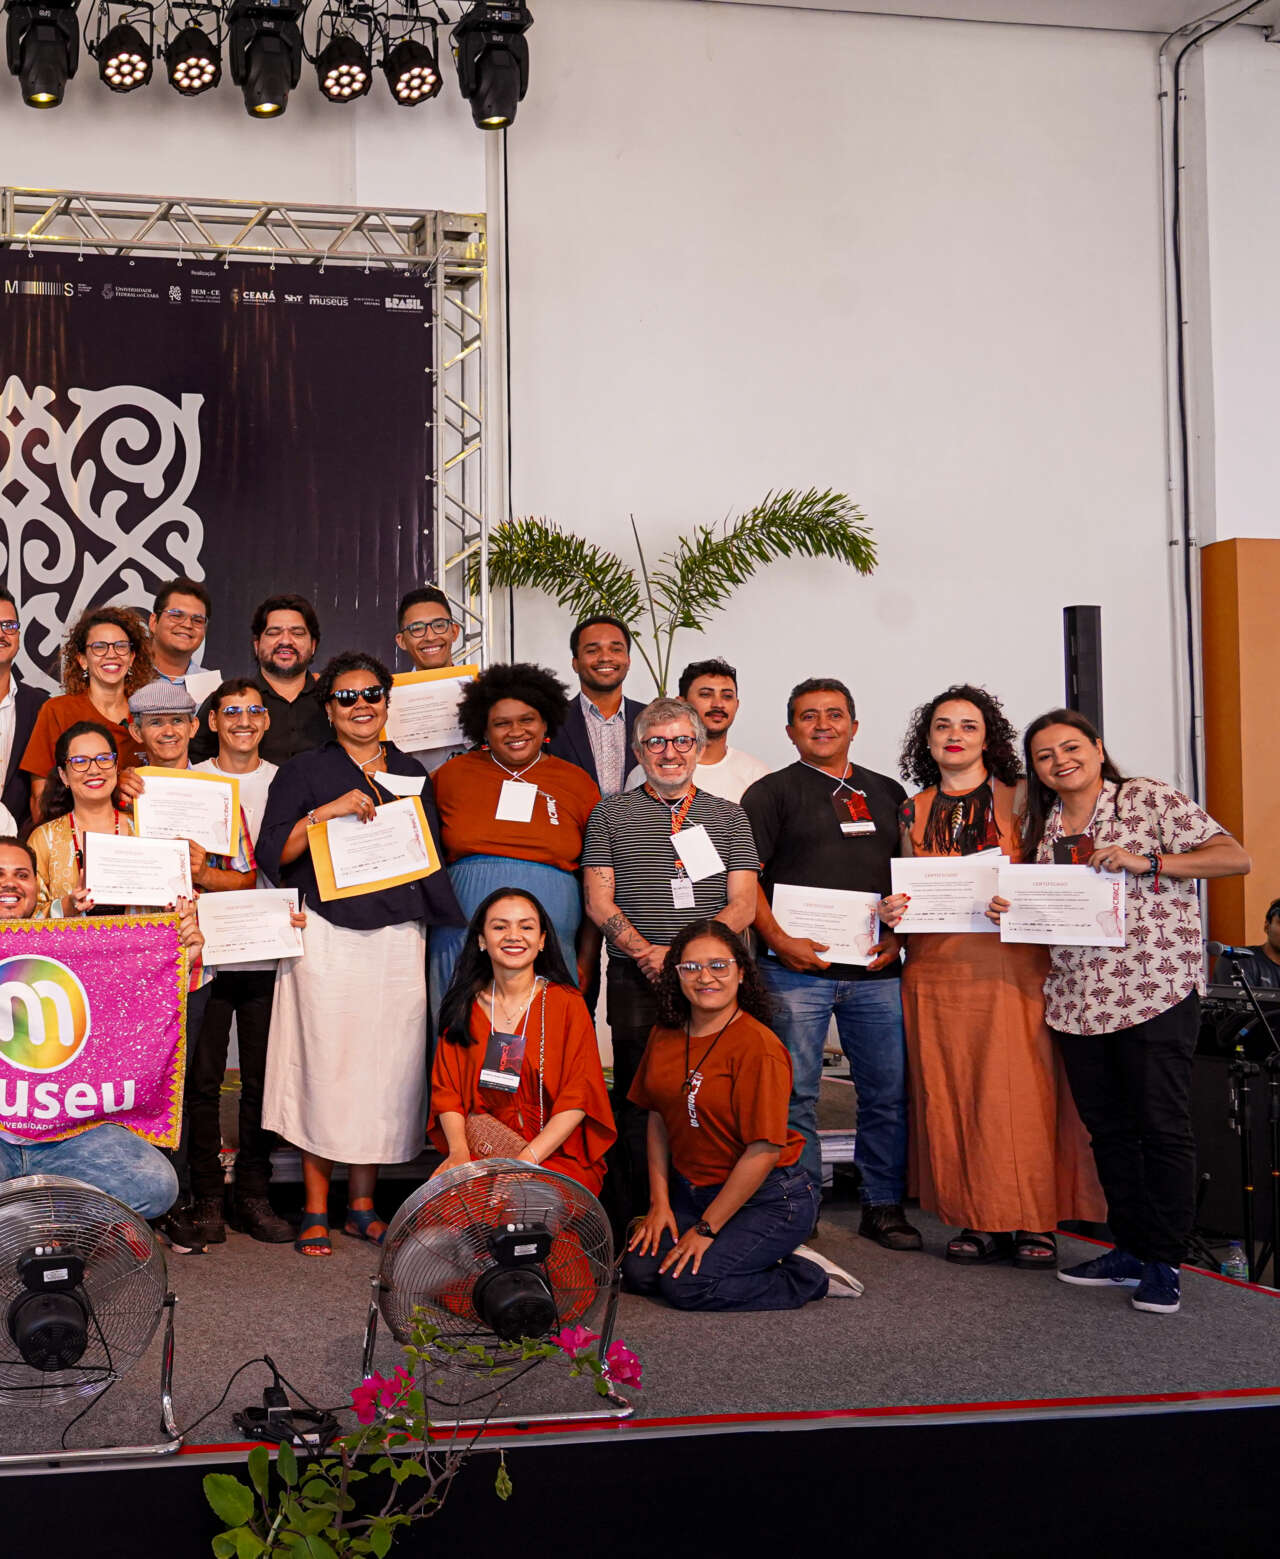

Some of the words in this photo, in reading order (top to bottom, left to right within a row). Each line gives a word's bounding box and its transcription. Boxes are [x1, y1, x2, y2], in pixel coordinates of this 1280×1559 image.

[243, 290, 276, 300] CEARÁ
[309, 297, 349, 306] museus
[385, 297, 424, 310] BRASIL
